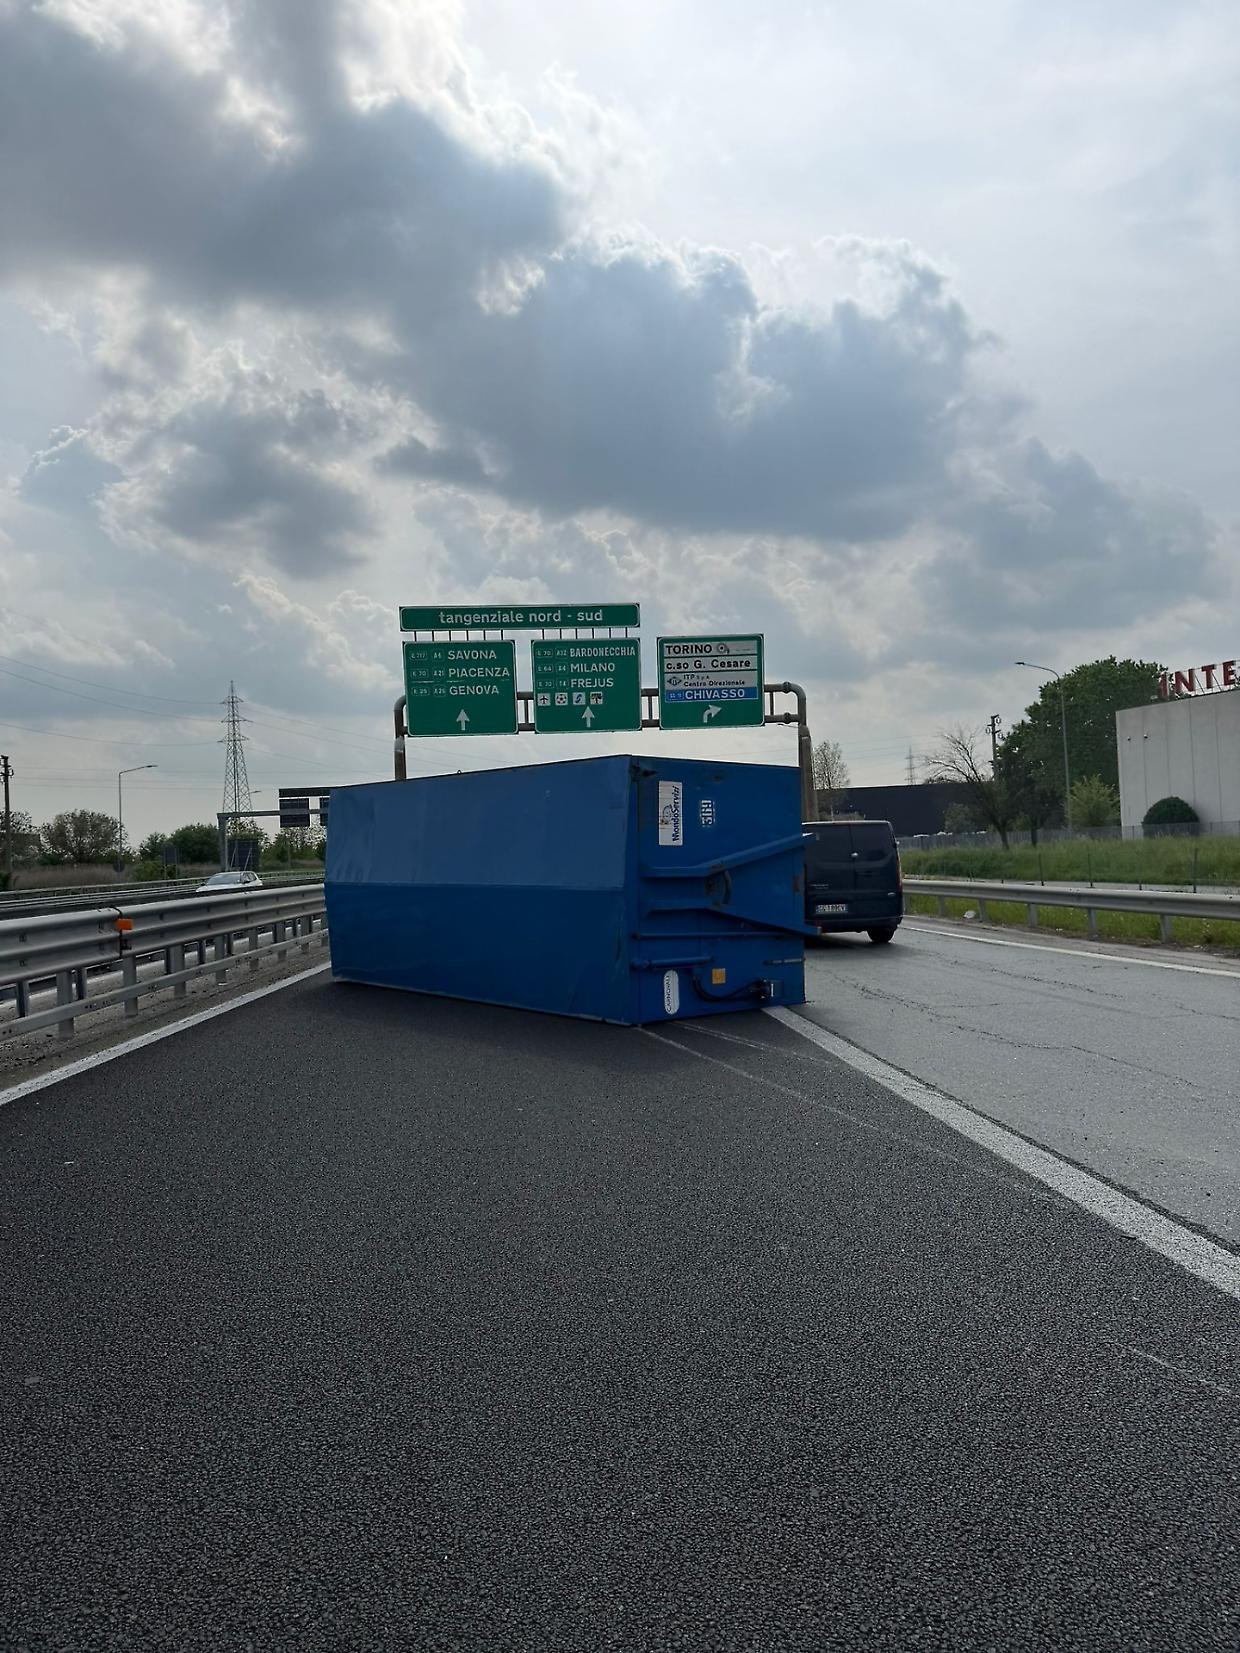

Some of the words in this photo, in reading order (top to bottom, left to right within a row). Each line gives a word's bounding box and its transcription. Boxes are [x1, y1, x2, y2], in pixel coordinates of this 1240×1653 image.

[438, 610, 524, 625] tangenziale
[529, 610, 561, 622] nord
[577, 609, 603, 621] sud
[447, 649, 497, 660] SAVONA
[569, 646, 636, 658] BARDONECCHIA
[665, 643, 712, 655] TORINO
[570, 662, 616, 673] MILANO
[666, 661, 689, 670] c.so
[693, 659, 706, 669] G.
[711, 658, 751, 668] Cesare
[448, 667, 510, 678] PIACENZA
[570, 677, 615, 688] FREJUS
[708, 679, 745, 687] Direzionale
[449, 685, 500, 696] GENOVA
[685, 688, 745, 700] CHIVASSO
